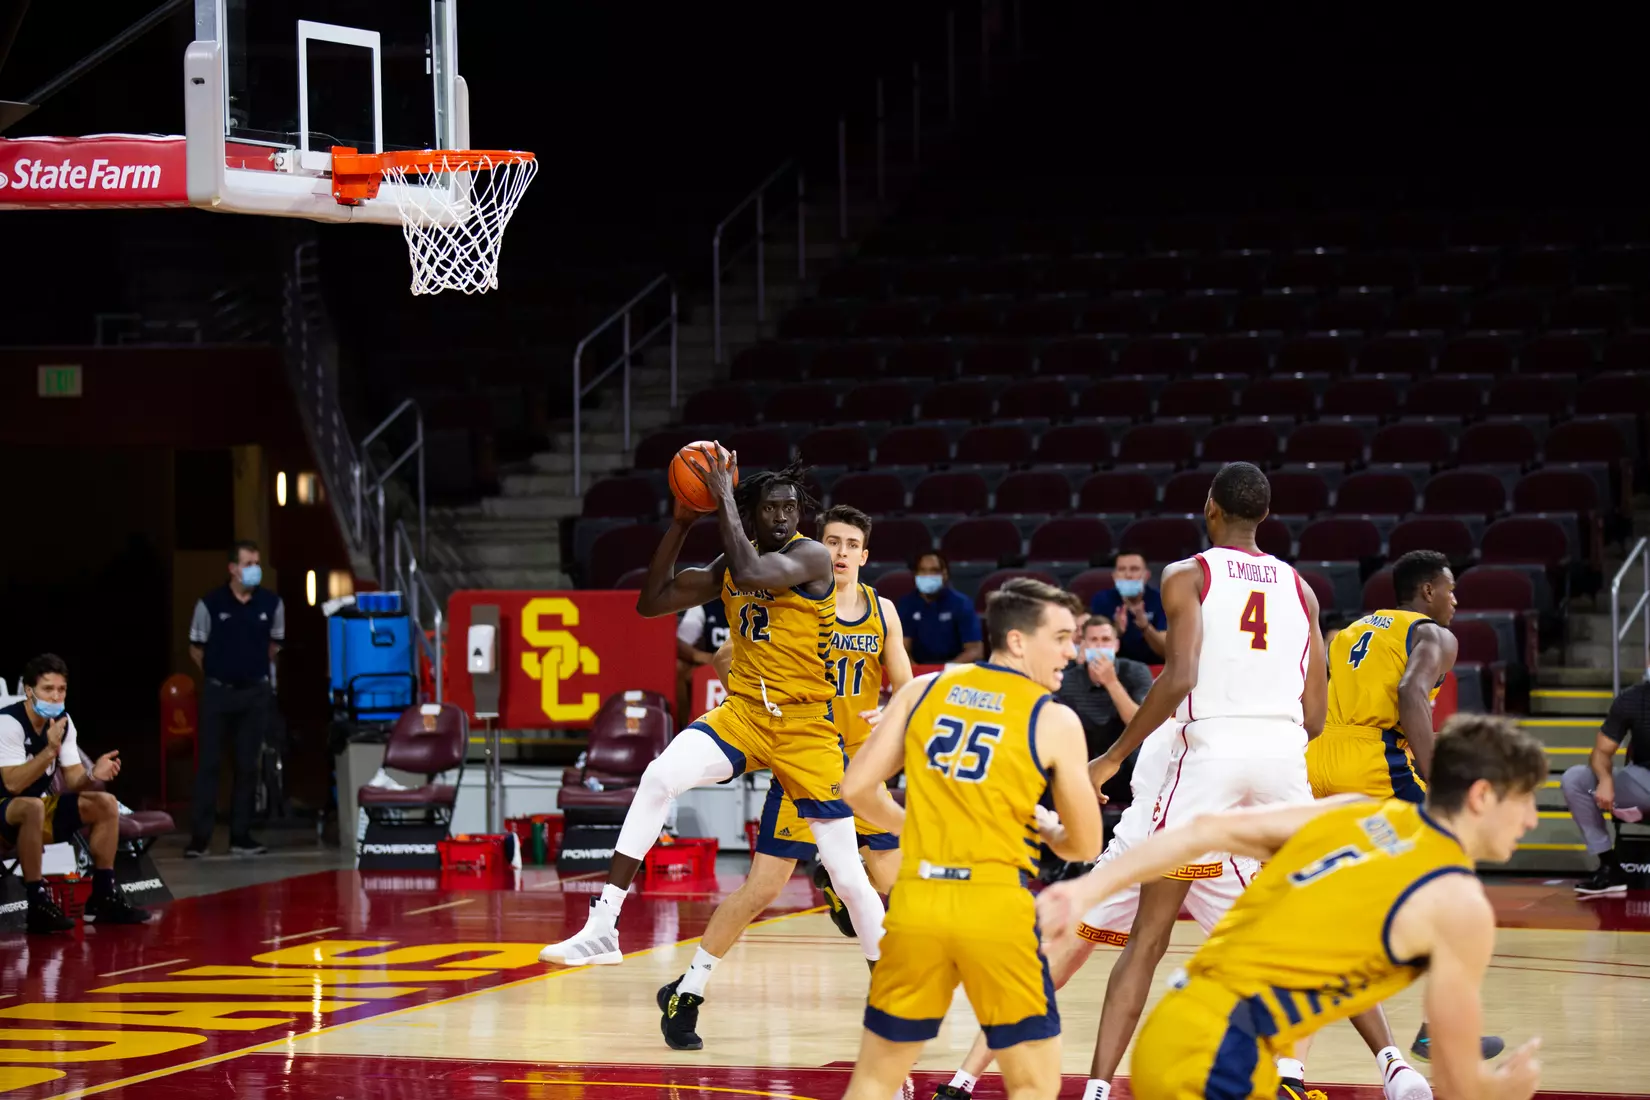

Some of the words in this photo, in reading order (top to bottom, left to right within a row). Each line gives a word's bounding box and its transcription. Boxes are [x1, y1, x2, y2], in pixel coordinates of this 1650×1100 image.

[1227, 560, 1278, 584] E.MOBLEY
[738, 602, 772, 642] 12
[1240, 590, 1268, 651] 4
[521, 597, 600, 722] SC
[829, 632, 880, 655] ANCERS
[1347, 630, 1376, 671] 4
[836, 656, 866, 698] 11
[945, 684, 1005, 713] ROWELL
[924, 713, 1004, 784] 25
[363, 843, 438, 855] POWERADE
[561, 847, 616, 860] POWERA
[119, 877, 164, 895] POWERADE
